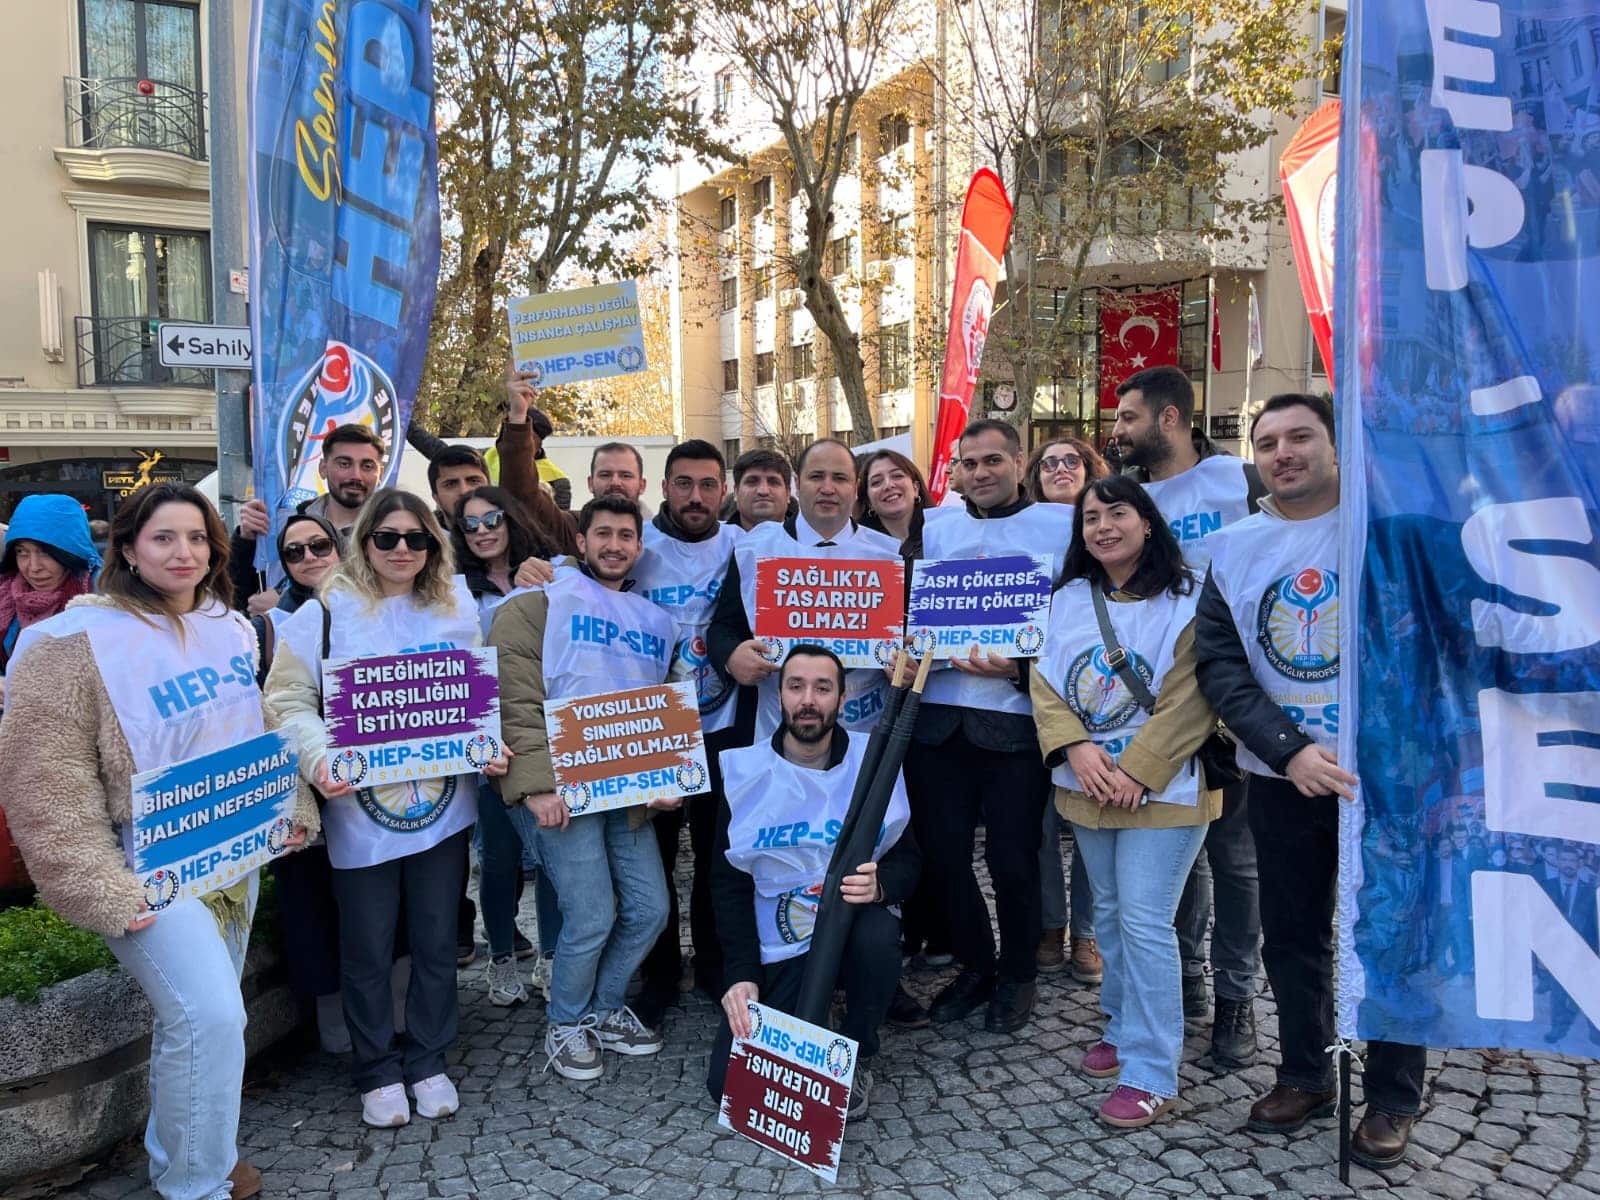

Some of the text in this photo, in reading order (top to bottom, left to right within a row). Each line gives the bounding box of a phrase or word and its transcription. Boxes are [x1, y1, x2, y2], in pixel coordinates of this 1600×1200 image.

[513, 303, 594, 325] PERFORMANS
[545, 351, 616, 374] HEP-SEN
[777, 565, 880, 587] SAĞLIKTA
[925, 570, 1040, 591] ASM ÇÖKERSE,
[774, 589, 884, 608] TASARRUF
[920, 591, 1040, 611] SİSTEM ÇÖKER!
[788, 611, 868, 629] OLMAZ!
[571, 614, 666, 661] HEP-SEN
[938, 629, 1015, 645] HEP-SEN
[354, 657, 466, 684] EMEĞİMİZİN
[1278, 660, 1305, 679] SAĞLIK
[352, 682, 469, 709] KARŞILIĞINI
[572, 694, 668, 720] YOKSULLUK
[357, 707, 466, 734] İSTİYORUZ!
[583, 717, 664, 741] SINIRINDA
[369, 740, 463, 768] HEP-SEN
[562, 733, 690, 768] SAĞLIK OLMAZ!
[143, 750, 290, 815] BİRİNCİ BASAMAK
[592, 768, 675, 798] HEP-SEN
[139, 773, 295, 846] HALKIN NEFESİDİR!
[388, 819, 419, 830] SAĞLIK
[180, 829, 266, 884] HEP-SEN
[760, 1025, 826, 1067] HEP-SEN
[745, 1052, 831, 1106] TOLERANS!
[764, 1087, 803, 1121] SIFIR
[747, 1108, 811, 1156] ŞİDDETE
